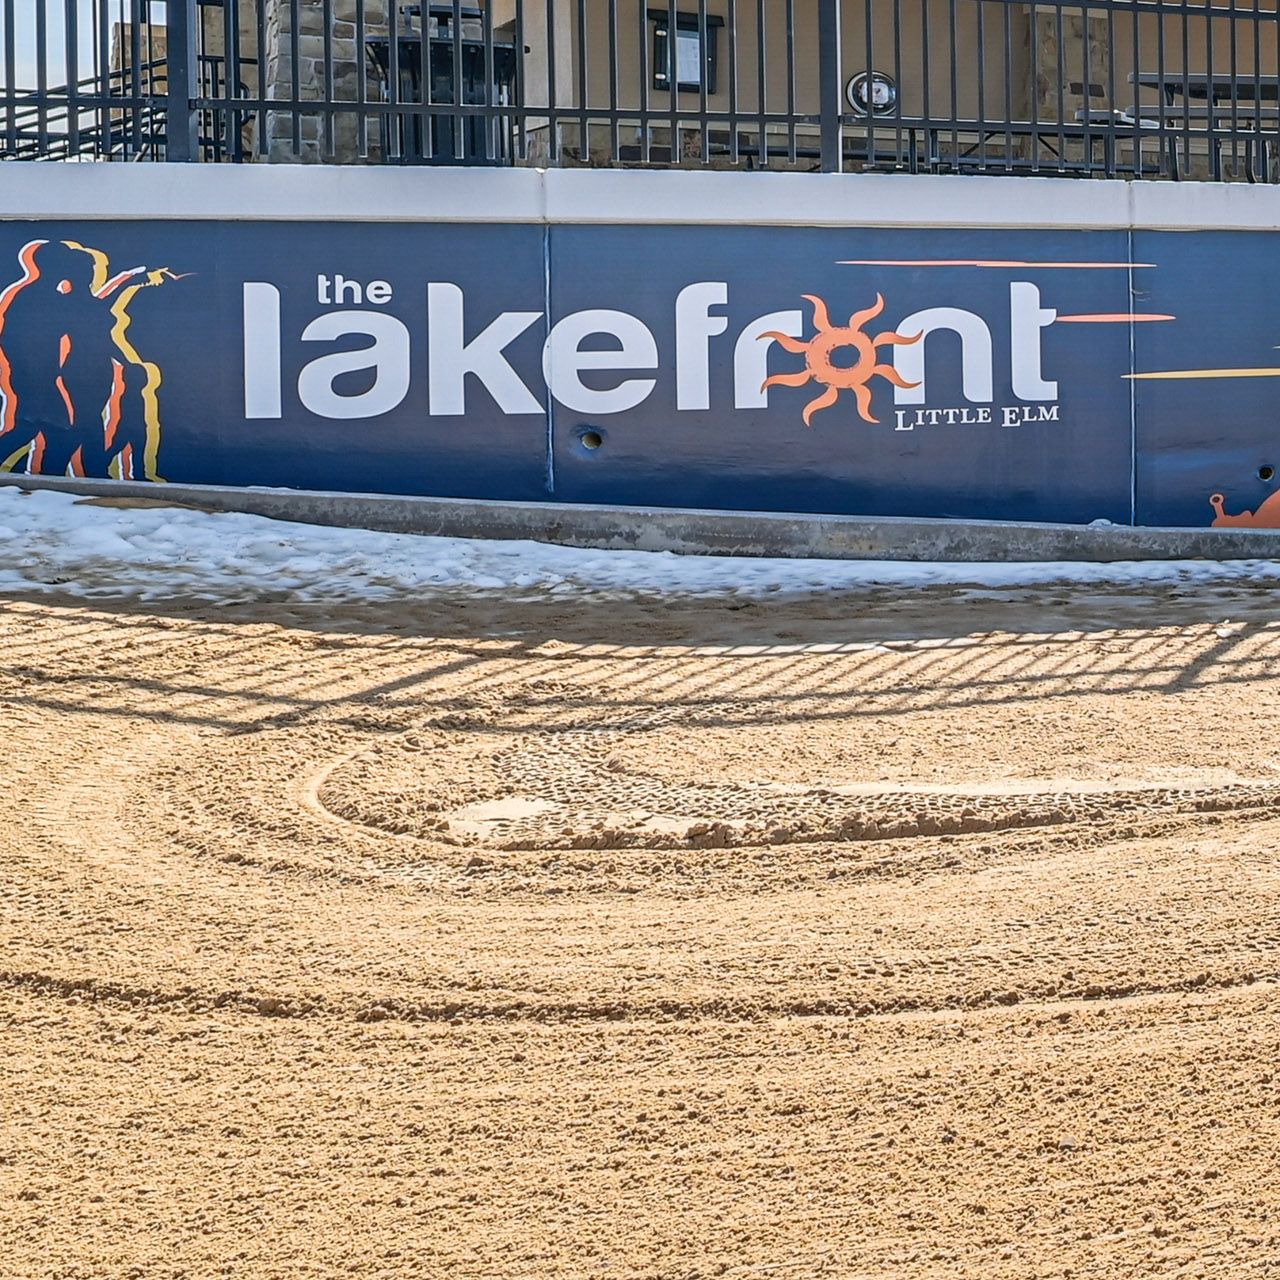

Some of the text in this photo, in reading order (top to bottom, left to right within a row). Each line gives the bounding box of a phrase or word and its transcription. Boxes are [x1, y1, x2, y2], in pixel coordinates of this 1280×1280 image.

[317, 274, 393, 304] the
[243, 281, 1058, 426] lakefront
[895, 405, 1060, 431] LITTLE ELM
